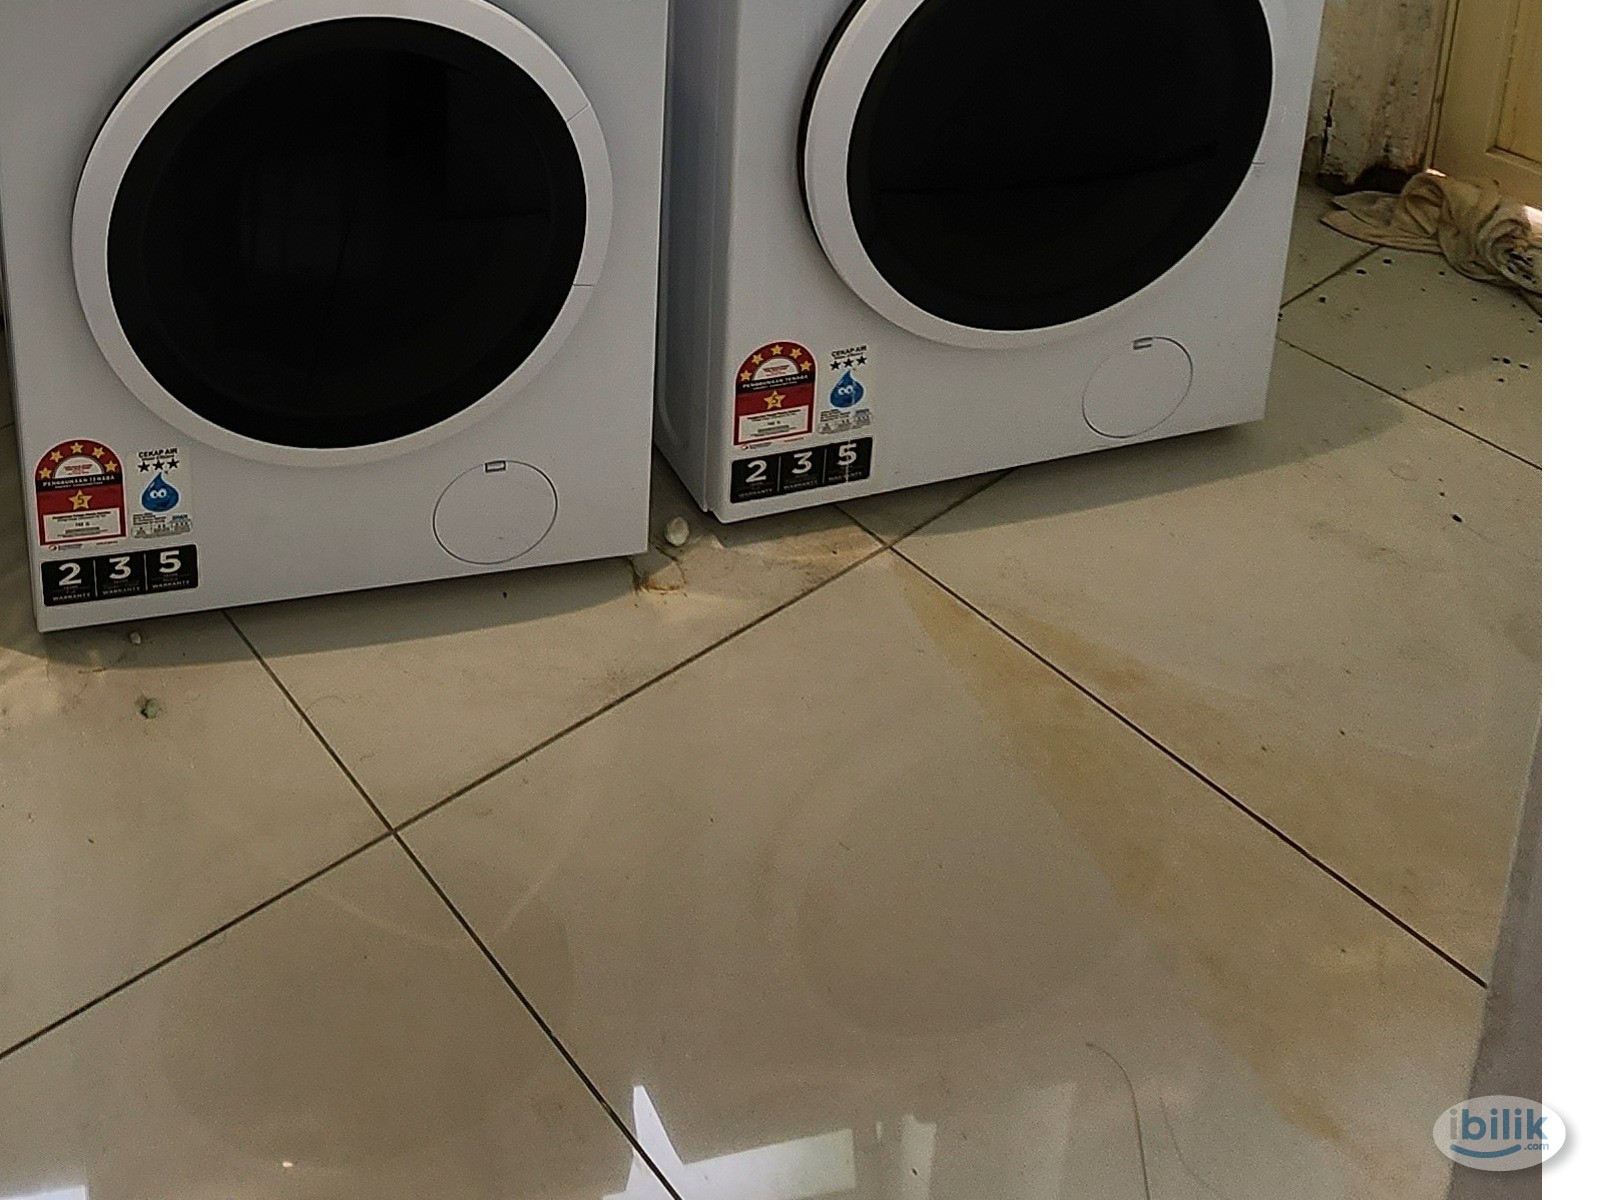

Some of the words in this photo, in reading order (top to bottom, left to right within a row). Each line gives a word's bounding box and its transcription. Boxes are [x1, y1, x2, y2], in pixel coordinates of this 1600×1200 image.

[791, 451, 813, 474] 3
[837, 443, 857, 466] 5
[746, 459, 767, 483] 2
[109, 556, 132, 579] 3
[159, 550, 182, 574] 5
[58, 562, 82, 586] 2
